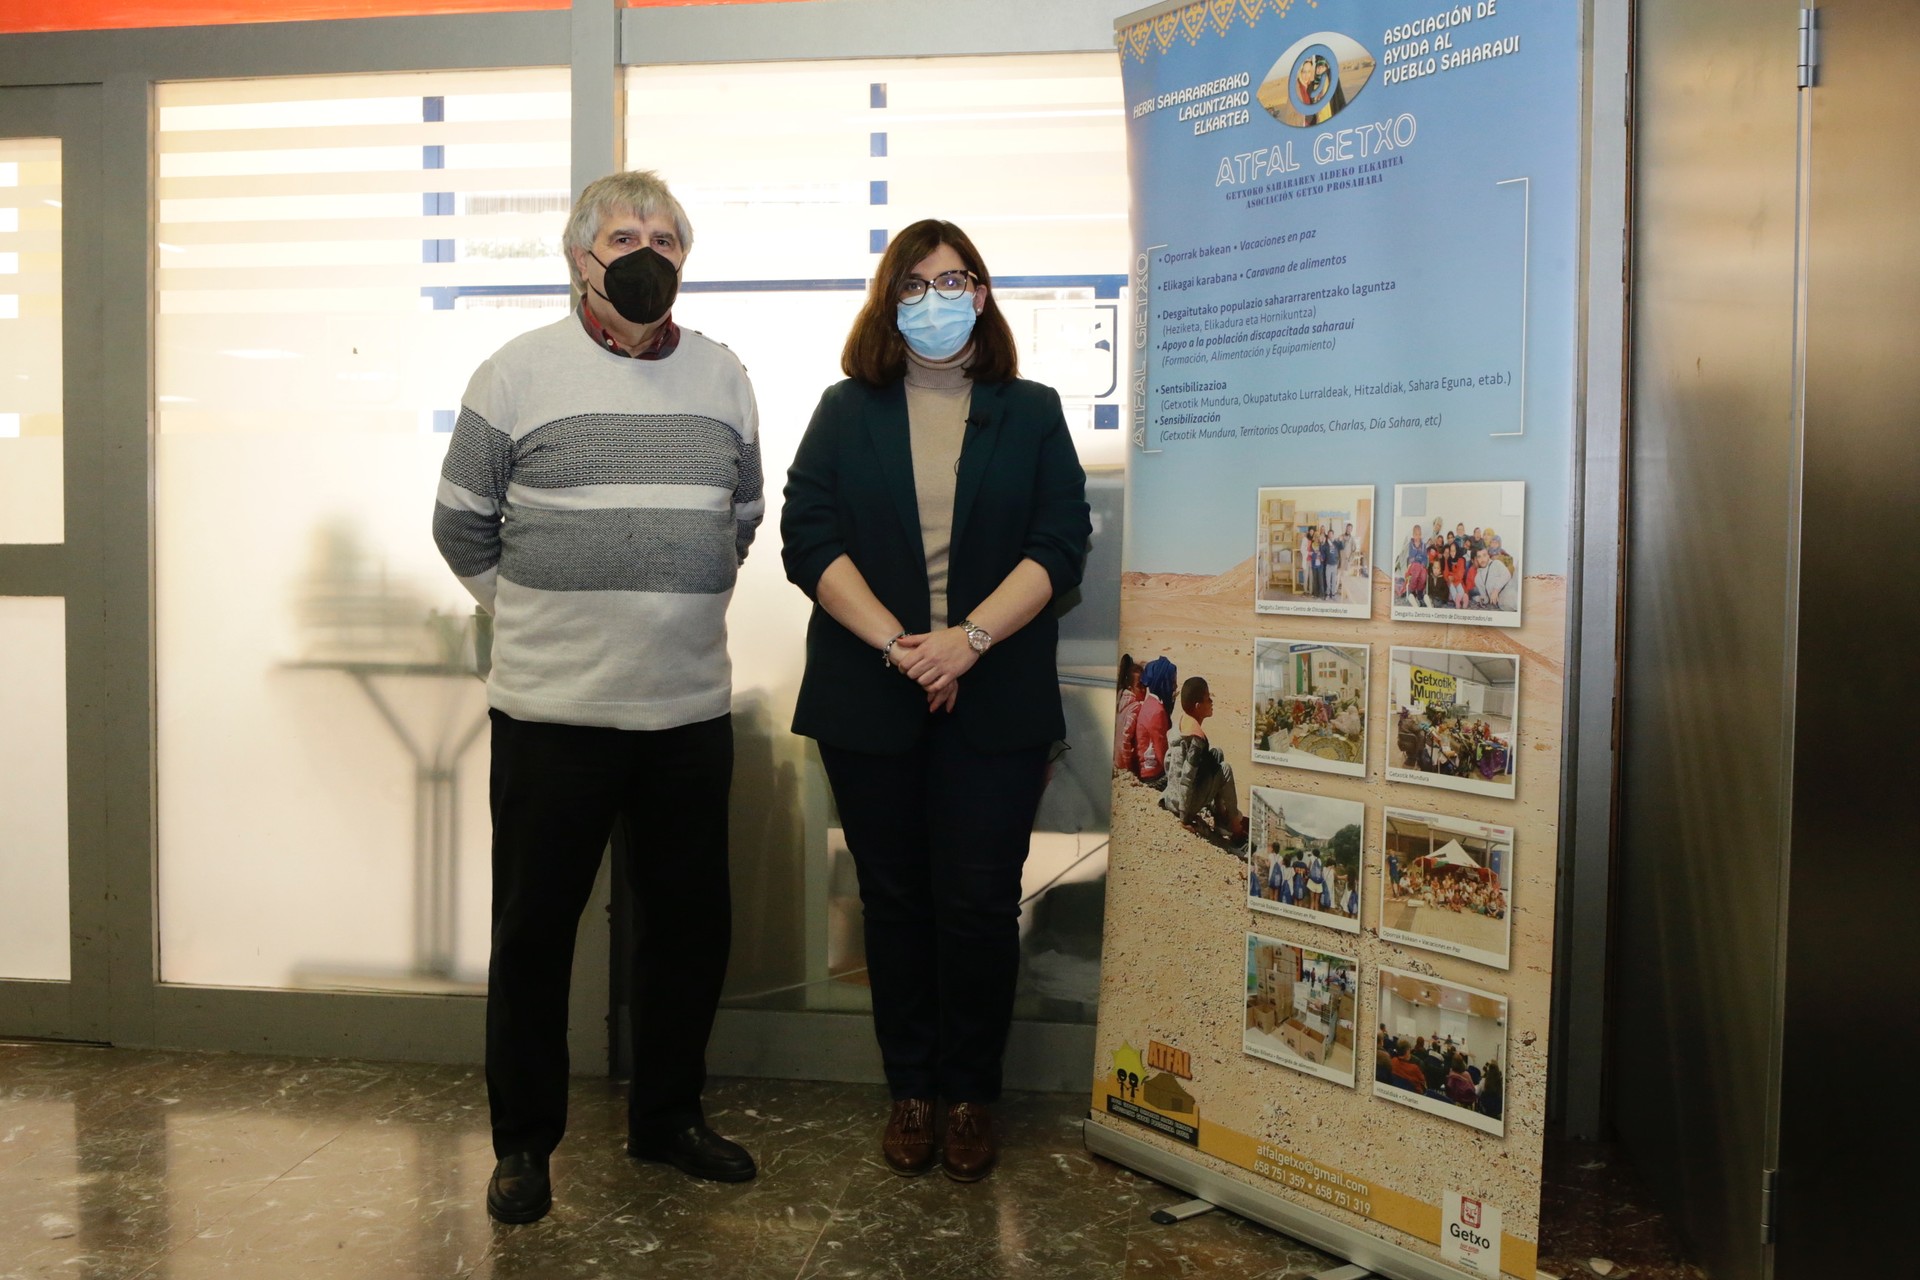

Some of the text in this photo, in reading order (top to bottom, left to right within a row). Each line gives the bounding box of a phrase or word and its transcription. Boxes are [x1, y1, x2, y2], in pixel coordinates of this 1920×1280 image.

[1384, 0, 1496, 46] ASOCIACIÓN DE
[1384, 33, 1453, 66] AYUDA AL
[1384, 35, 1520, 86] PUEBLO SAHARAUI
[1133, 72, 1250, 119] HERRI SAHARARRERAKO
[1179, 90, 1250, 122] LAGUNTZAKO
[1194, 109, 1250, 136] ELKARTEA
[1216, 112, 1416, 187] ATFAL GETXO
[1226, 155, 1404, 201] GETXOKO SAHARAREN ALDEKO ELKARTEA
[1245, 174, 1384, 210] ASOCIACIÓN GETXO PROSAHARA
[1164, 229, 1316, 266] Oporrak bakean Vacaciones en paz
[1163, 254, 1347, 292] Elikagai karabana Caravana de alimentos
[1162, 280, 1396, 321] Desgaitutako populazio sahararrarentzako laguntza
[1162, 305, 1316, 337] (Heziketa, Elikadura eta Hornikuntza)
[1162, 318, 1355, 352] Apoyo a la población discapacitada saharaui
[1132, 253, 1148, 448] ATFAL GETXO
[1162, 336, 1336, 368] (Formación, Alimentación y Equipamiento)
[1160, 380, 1227, 394] Sentsibilizazioa
[1160, 371, 1512, 412] (Getxotik Mundura, Okupatutako Lurraldeak, Hitzaldiak, Sahara Eguna, etab.)
[1160, 412, 1221, 426] Sensibilización
[1160, 413, 1442, 442] (Getxotik Mundura, Territorios Ocupados, Charlas, Día Sahara, etc)
[1414, 670, 1452, 688] Getxotik
[1148, 1040, 1192, 1080] ATFAL
[1254, 1160, 1371, 1215] 658 751 359 658 751 319
[1256, 1145, 1368, 1196] atfalgetxo@gmail.com
[1450, 1222, 1490, 1249] Getxo
